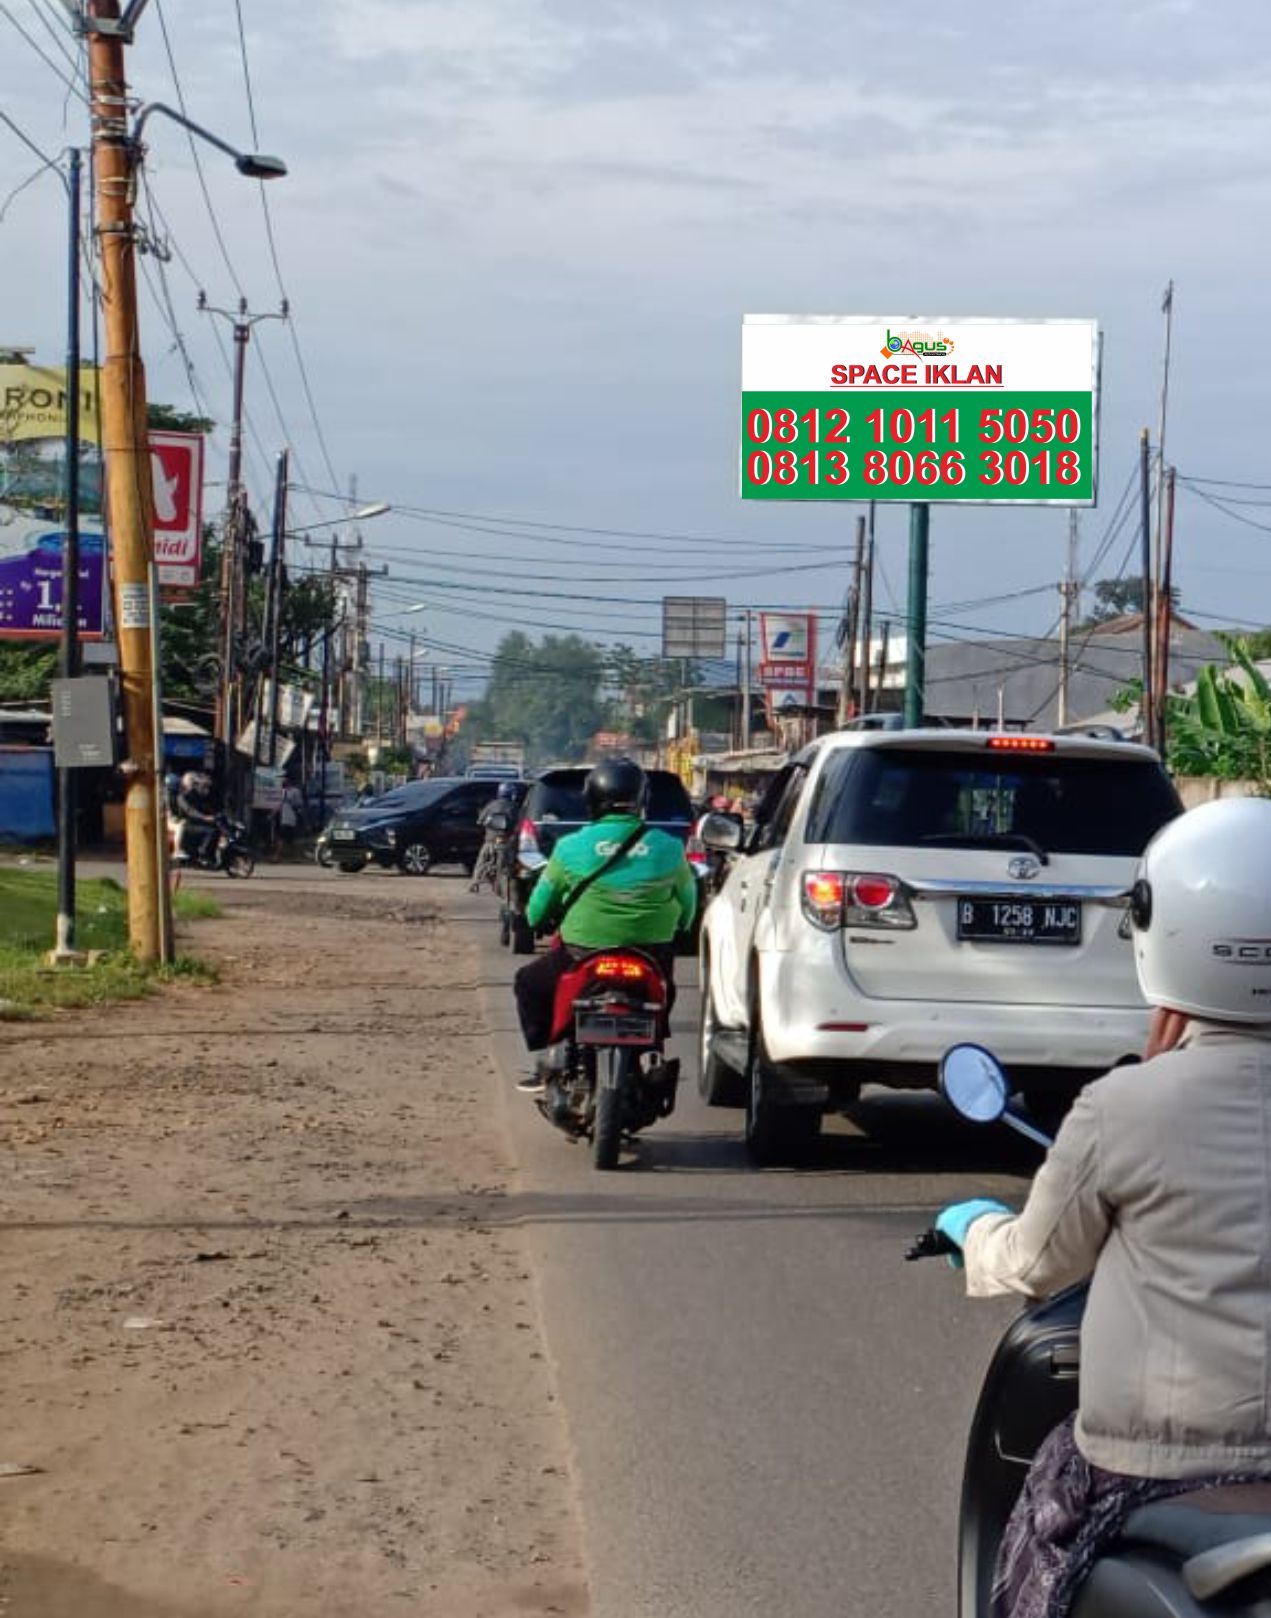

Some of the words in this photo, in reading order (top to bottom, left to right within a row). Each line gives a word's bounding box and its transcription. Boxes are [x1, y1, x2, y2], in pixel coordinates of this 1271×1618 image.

[831, 364, 917, 385] SPACE
[925, 364, 1003, 385] IKLAN
[747, 408, 850, 444] 0812
[865, 408, 960, 444] 1011
[978, 408, 1082, 444] 5050
[747, 450, 850, 486] 0813
[863, 450, 966, 486] 8066
[978, 450, 1082, 486] 3018
[962, 902, 974, 924] B
[993, 904, 1033, 927] 1258
[1045, 906, 1076, 928] NJC
